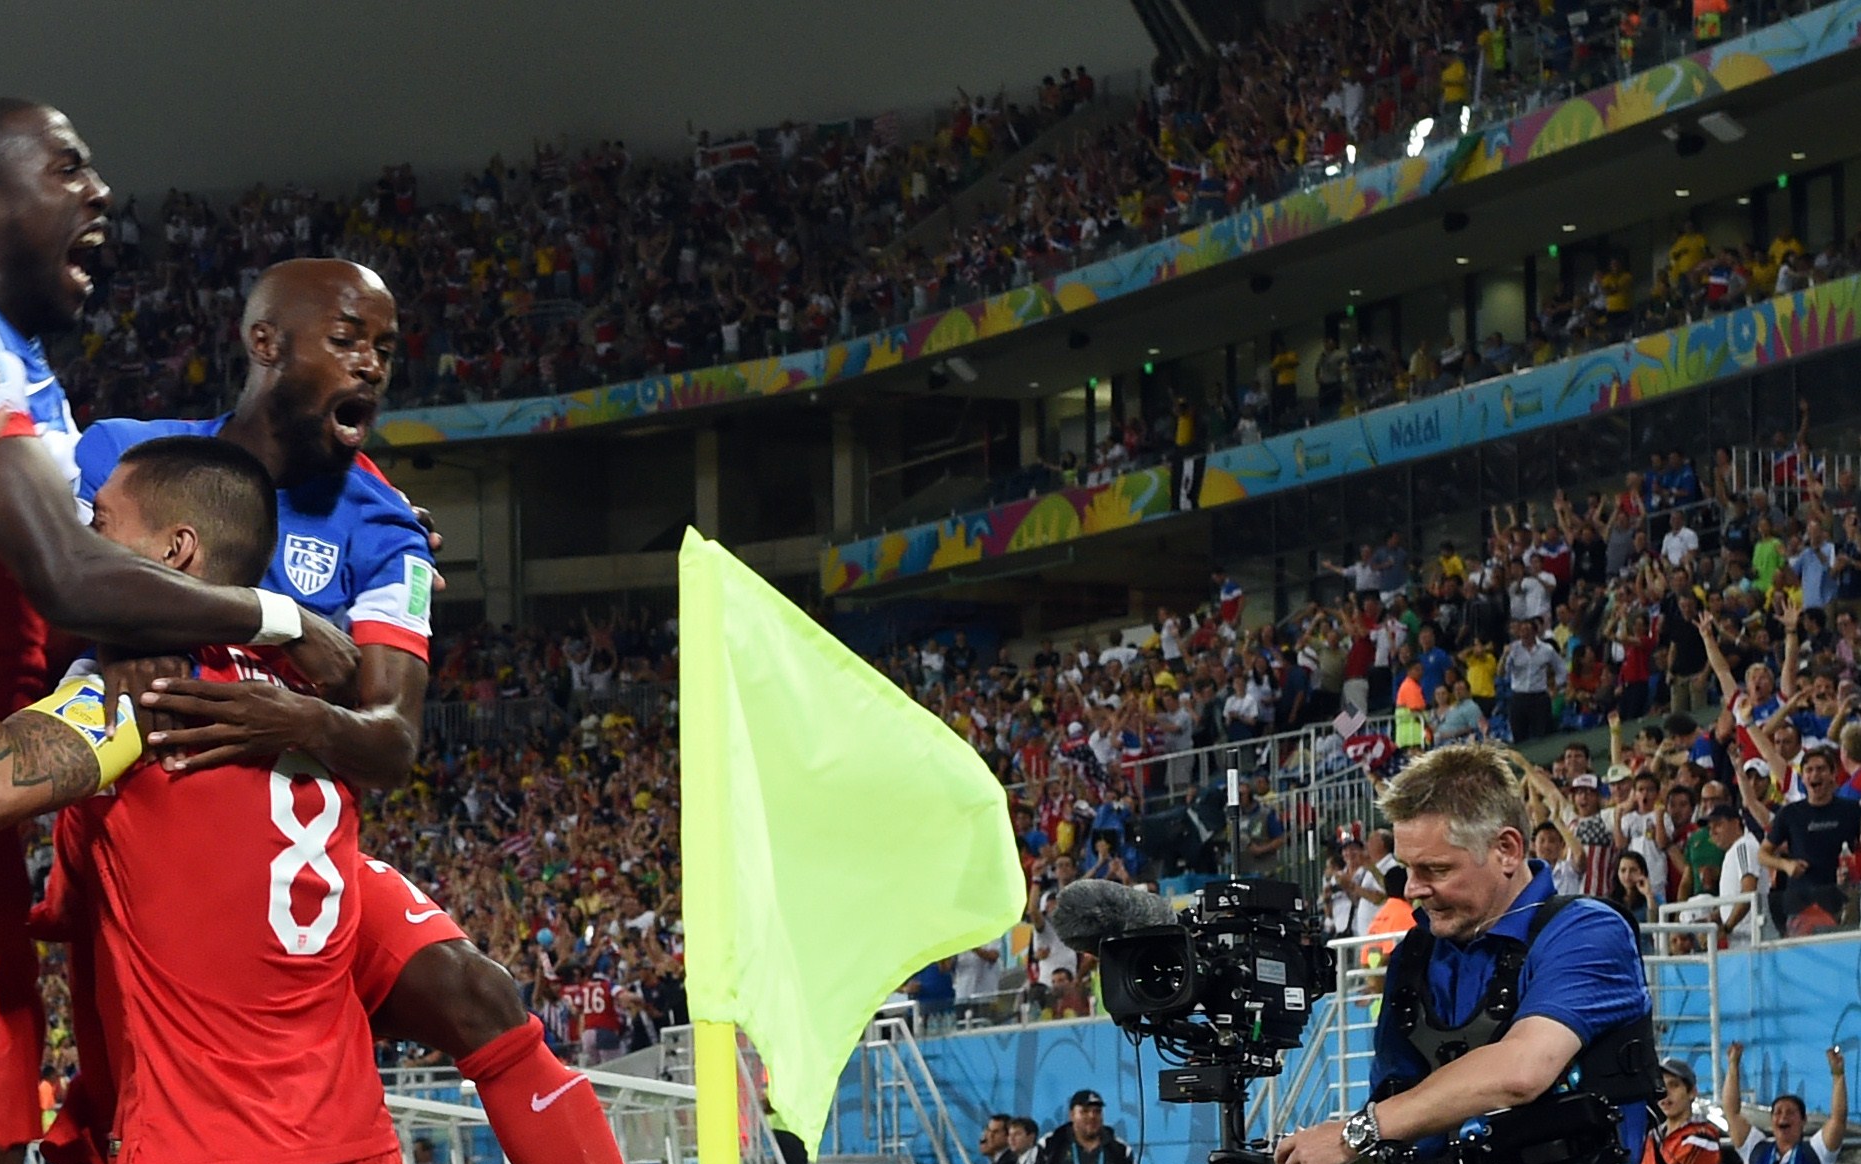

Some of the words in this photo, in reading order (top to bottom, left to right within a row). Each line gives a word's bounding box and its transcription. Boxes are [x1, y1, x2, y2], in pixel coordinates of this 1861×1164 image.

[1389, 409, 1441, 452] Natal
[268, 748, 344, 955] 8
[582, 987, 606, 1015] 16
